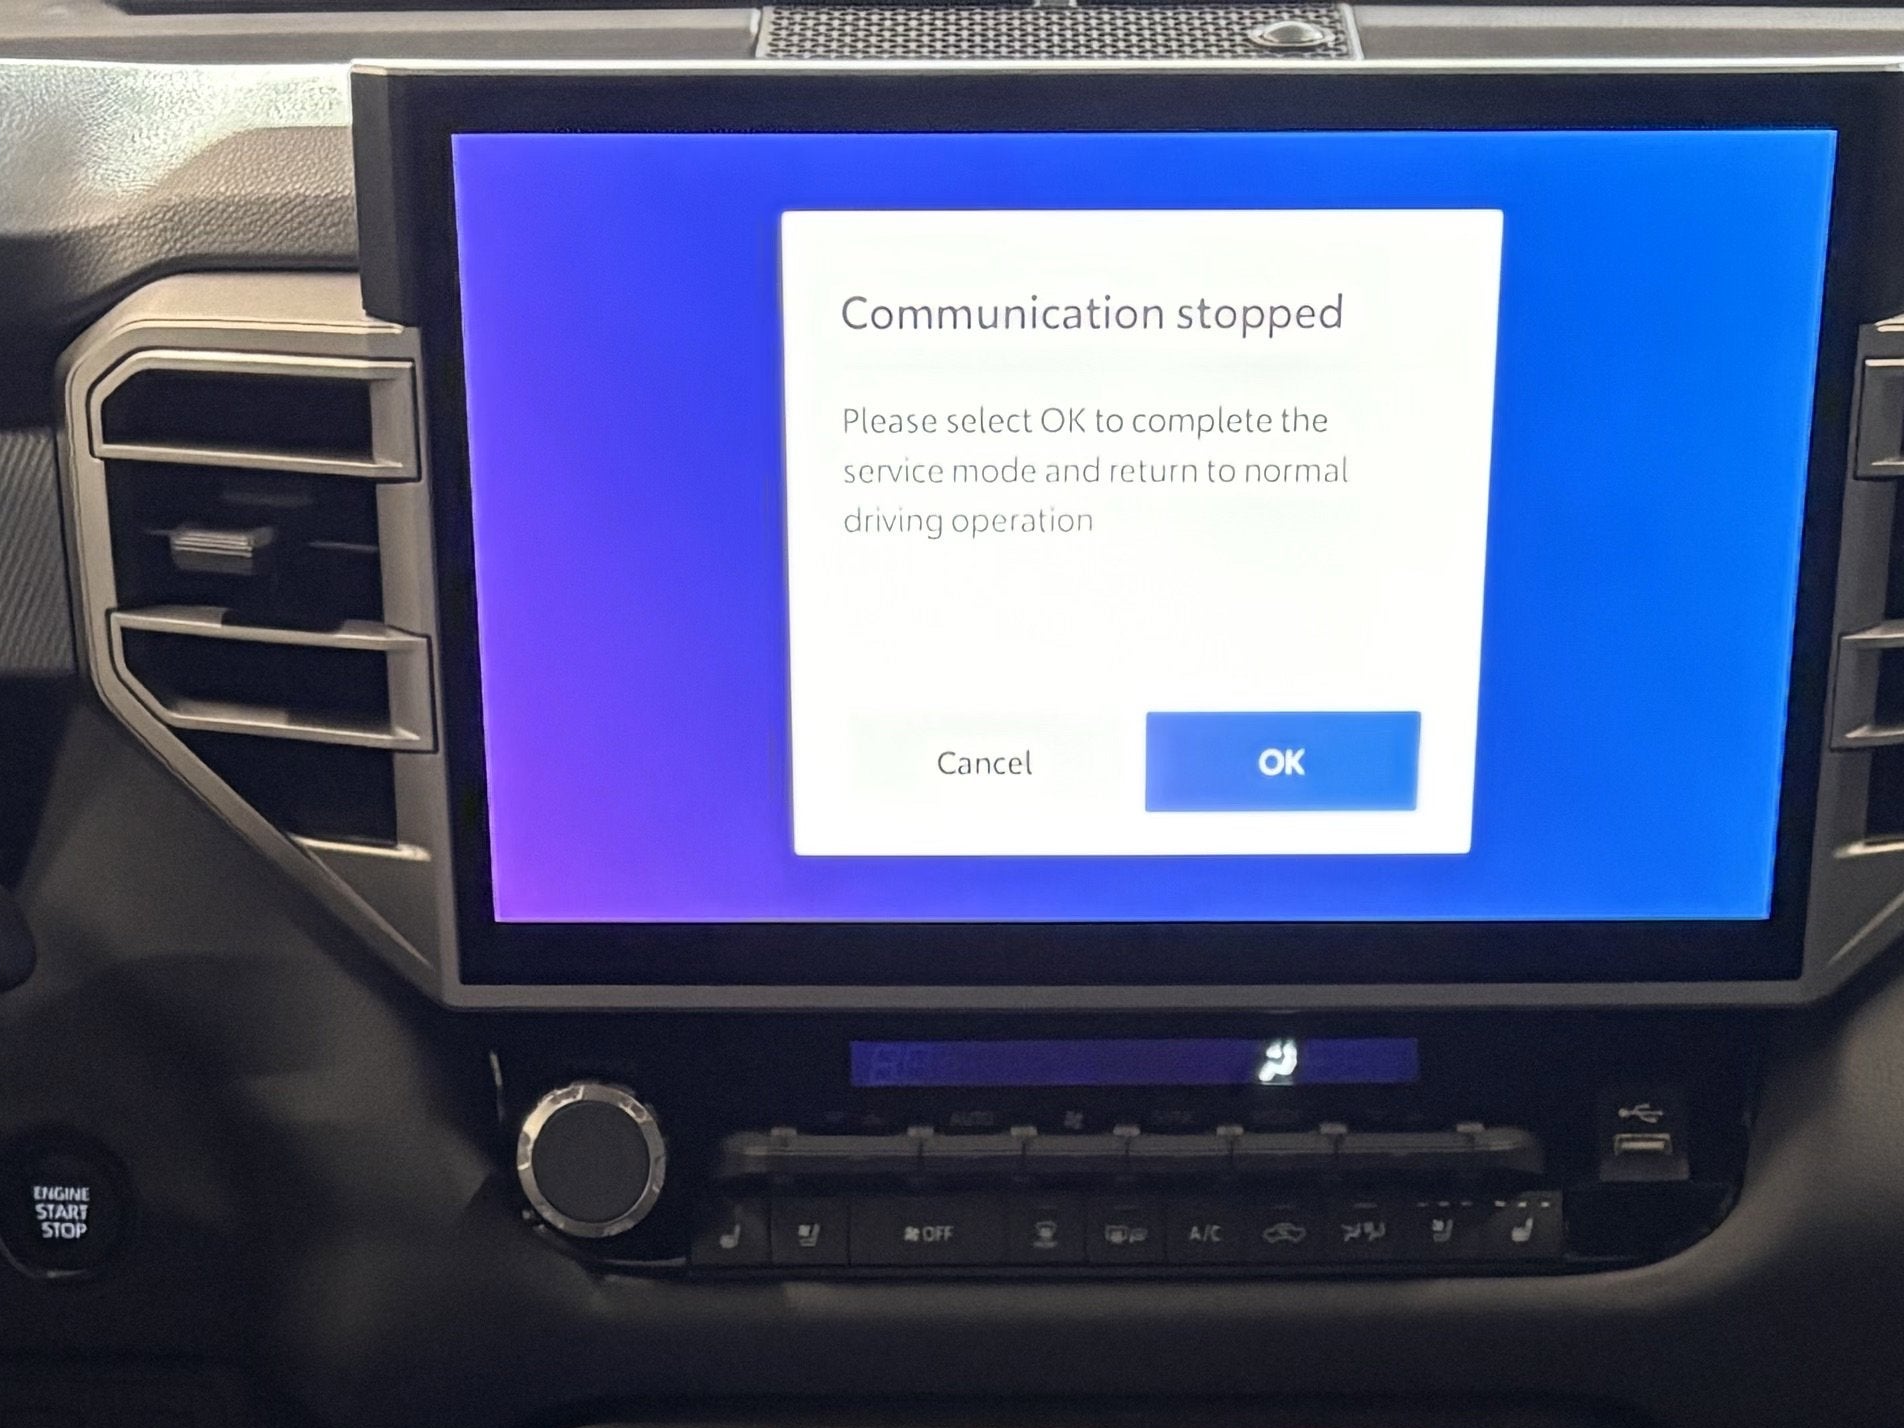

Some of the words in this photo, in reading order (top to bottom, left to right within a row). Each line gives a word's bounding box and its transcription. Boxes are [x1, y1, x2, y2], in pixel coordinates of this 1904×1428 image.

[841, 294, 1164, 331] Communication
[1177, 293, 1344, 338] stopped
[843, 406, 938, 435] Please
[946, 405, 1033, 435] select
[1040, 407, 1086, 434] OK
[1096, 409, 1125, 434] to
[1131, 405, 1274, 440] complete
[1281, 406, 1329, 434] the
[843, 458, 944, 485] service
[952, 458, 1038, 485] mode
[1046, 457, 1101, 484] and
[1109, 460, 1198, 484] return
[1207, 461, 1237, 484] to
[1244, 456, 1348, 484] normal
[844, 506, 944, 540] driving
[951, 508, 1093, 539] operation
[937, 750, 1033, 777] Cancel
[1258, 748, 1305, 776] OK
[33, 1186, 90, 1201] ENGINE
[35, 1203, 88, 1220] START
[41, 1221, 87, 1239] STOP
[922, 1226, 953, 1241] OFF
[1189, 1225, 1222, 1241] A/C
